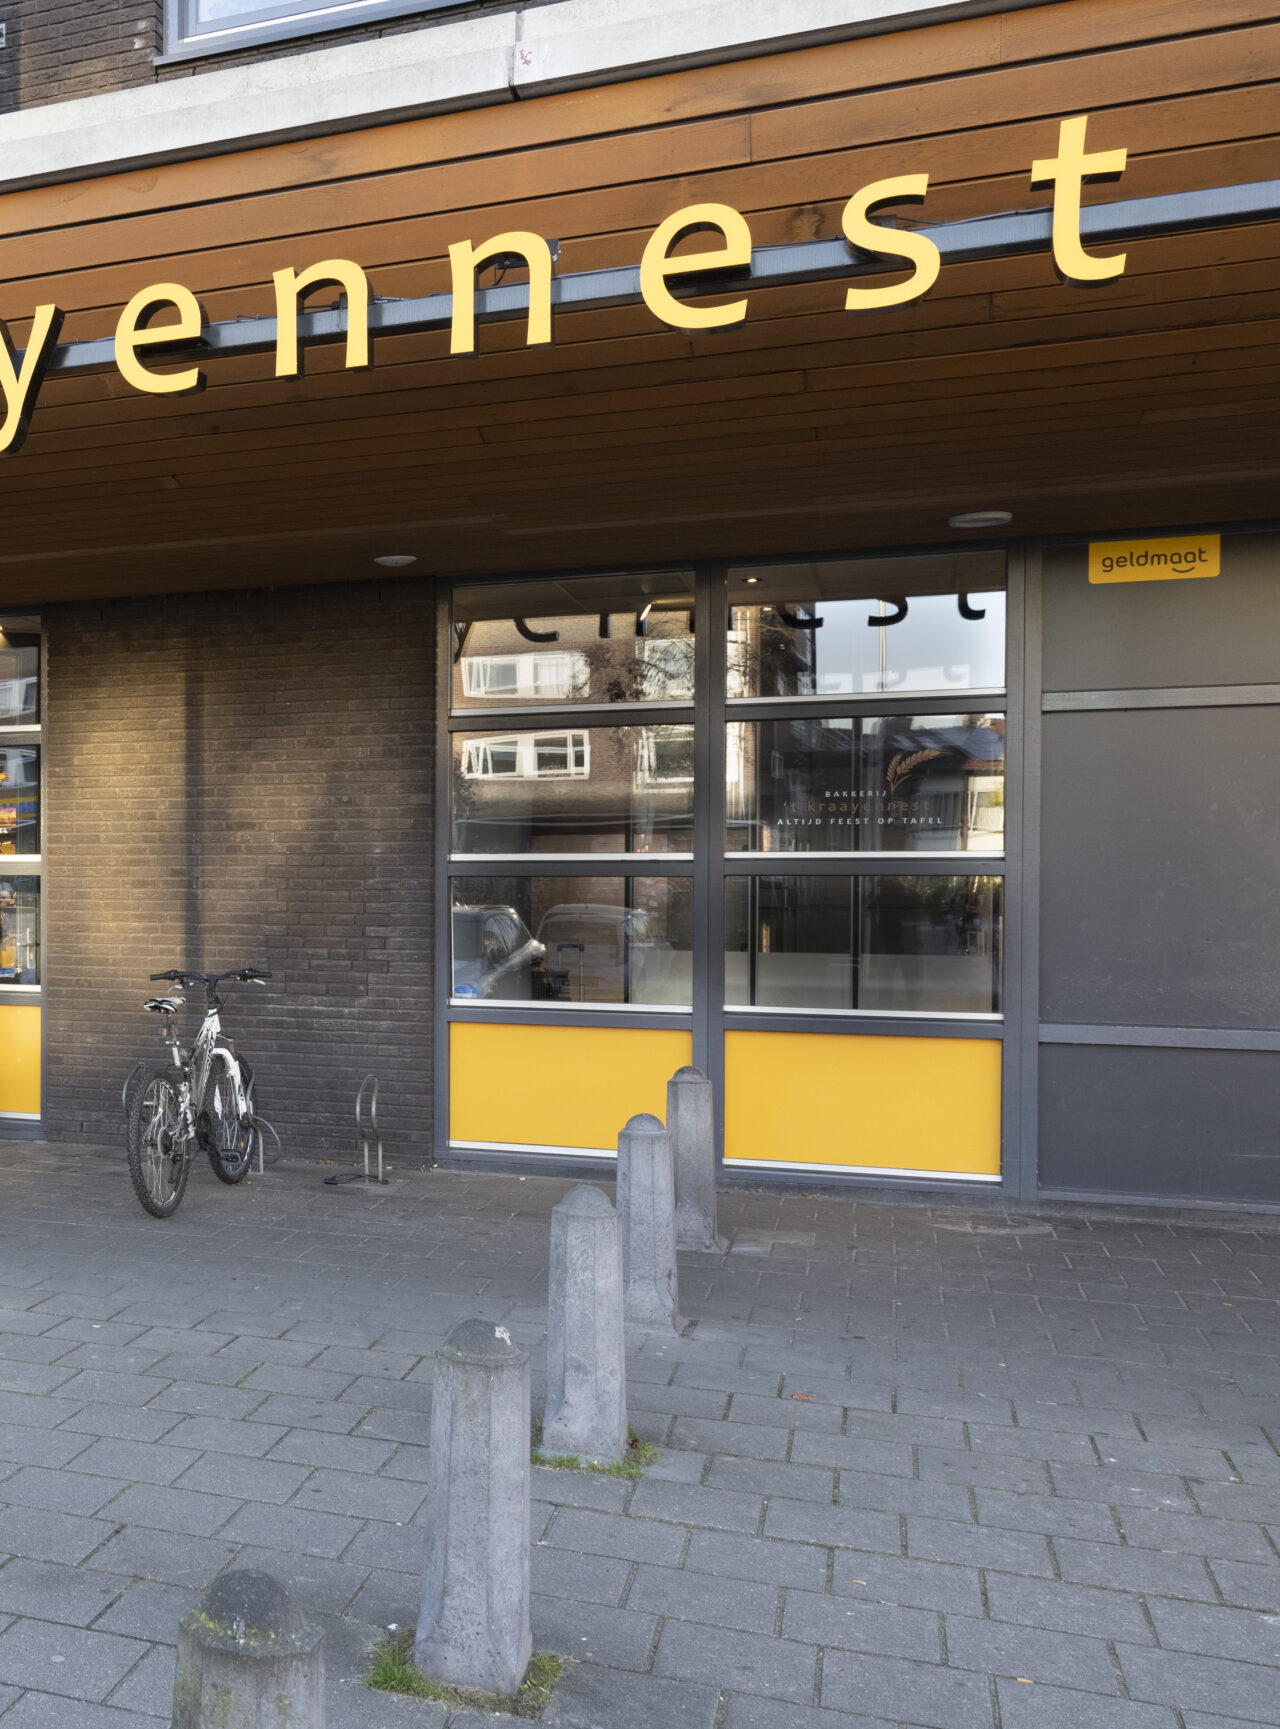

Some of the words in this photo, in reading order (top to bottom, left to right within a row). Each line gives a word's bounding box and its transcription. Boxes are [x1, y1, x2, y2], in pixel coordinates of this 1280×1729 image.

[1101, 547, 1209, 573] geldmaat
[825, 790, 887, 798] BAKKERIJ
[807, 800, 929, 817] kraayennest
[830, 817, 869, 825] FEEST
[877, 817, 895, 825] OP
